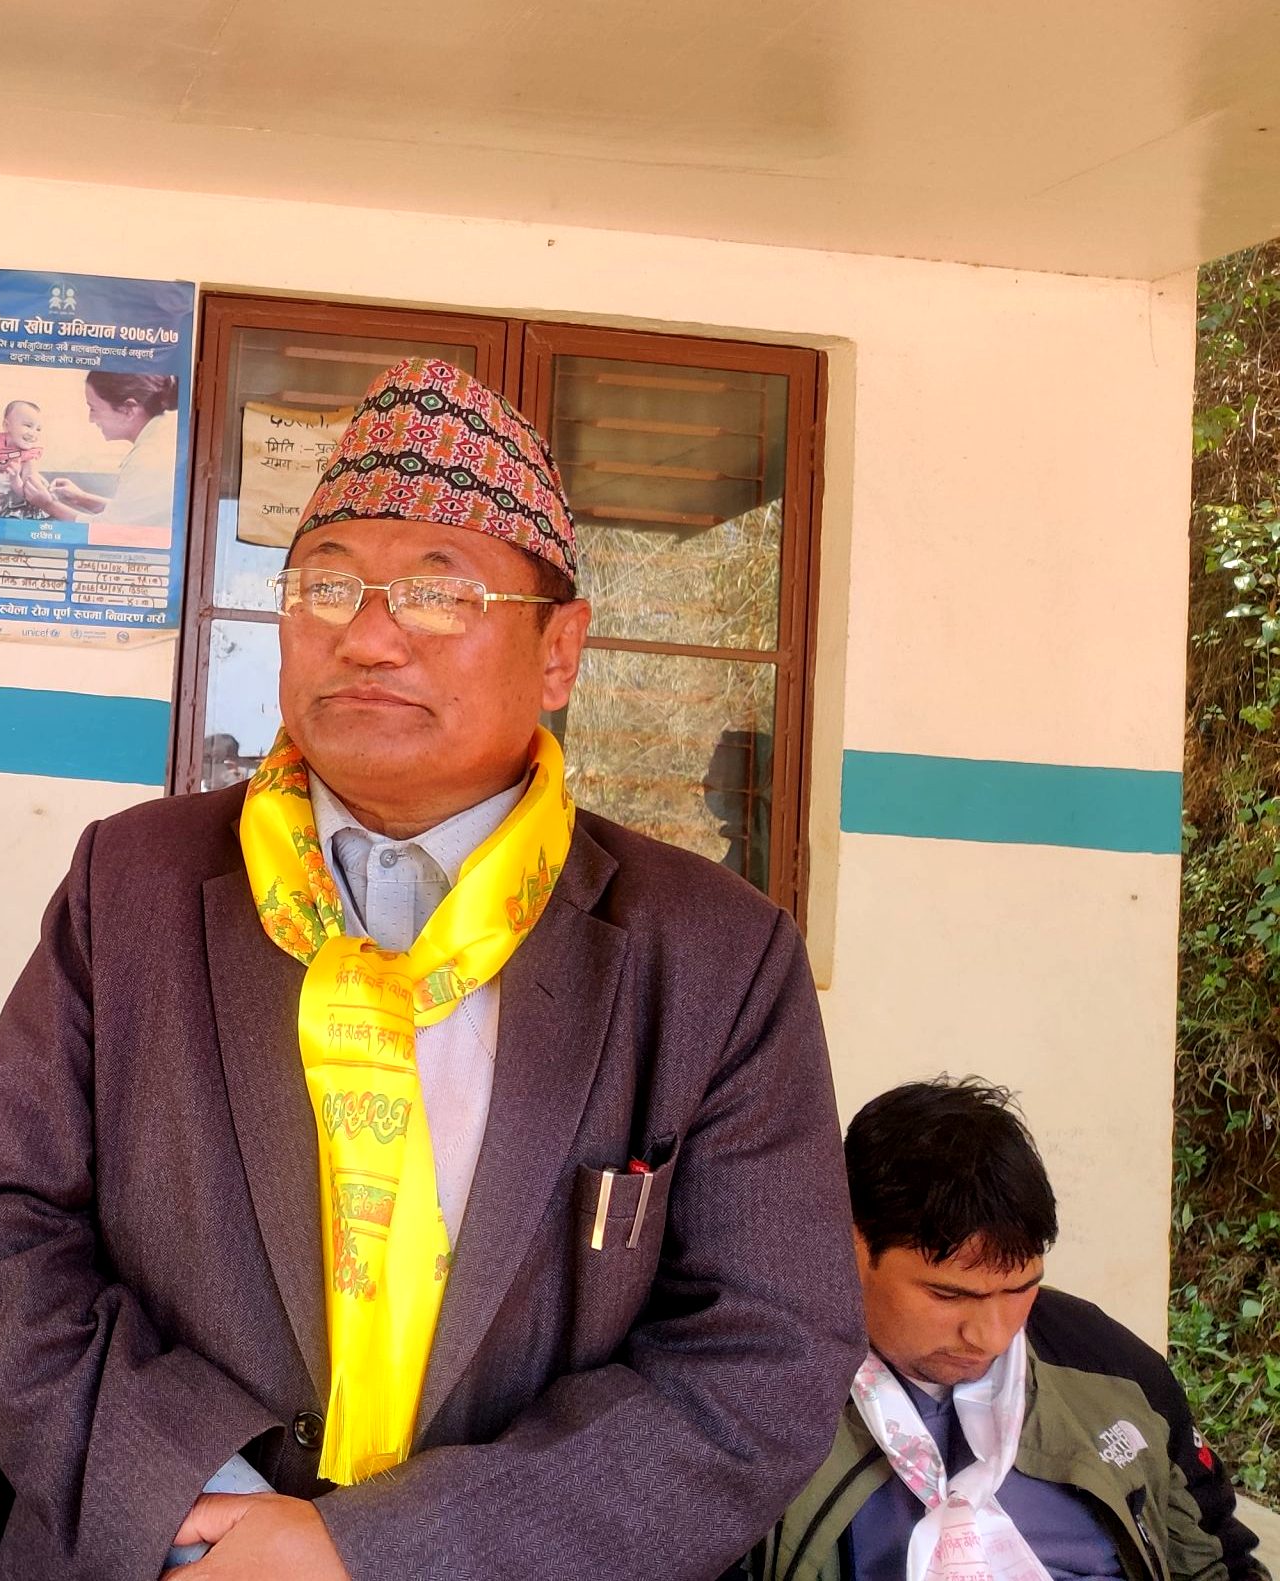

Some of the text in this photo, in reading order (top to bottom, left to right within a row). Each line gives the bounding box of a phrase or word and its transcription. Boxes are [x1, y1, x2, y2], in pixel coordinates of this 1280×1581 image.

[24, 316, 54, 335] खोप
[58, 318, 116, 340] अभियान
[120, 326, 179, 344] २०७६/७७
[265, 437, 295, 454] मिति
[261, 456, 292, 471] समय
[105, 608, 144, 623] निवारण
[22, 628, 48, 638] unicef
[1099, 1423, 1123, 1446] THE
